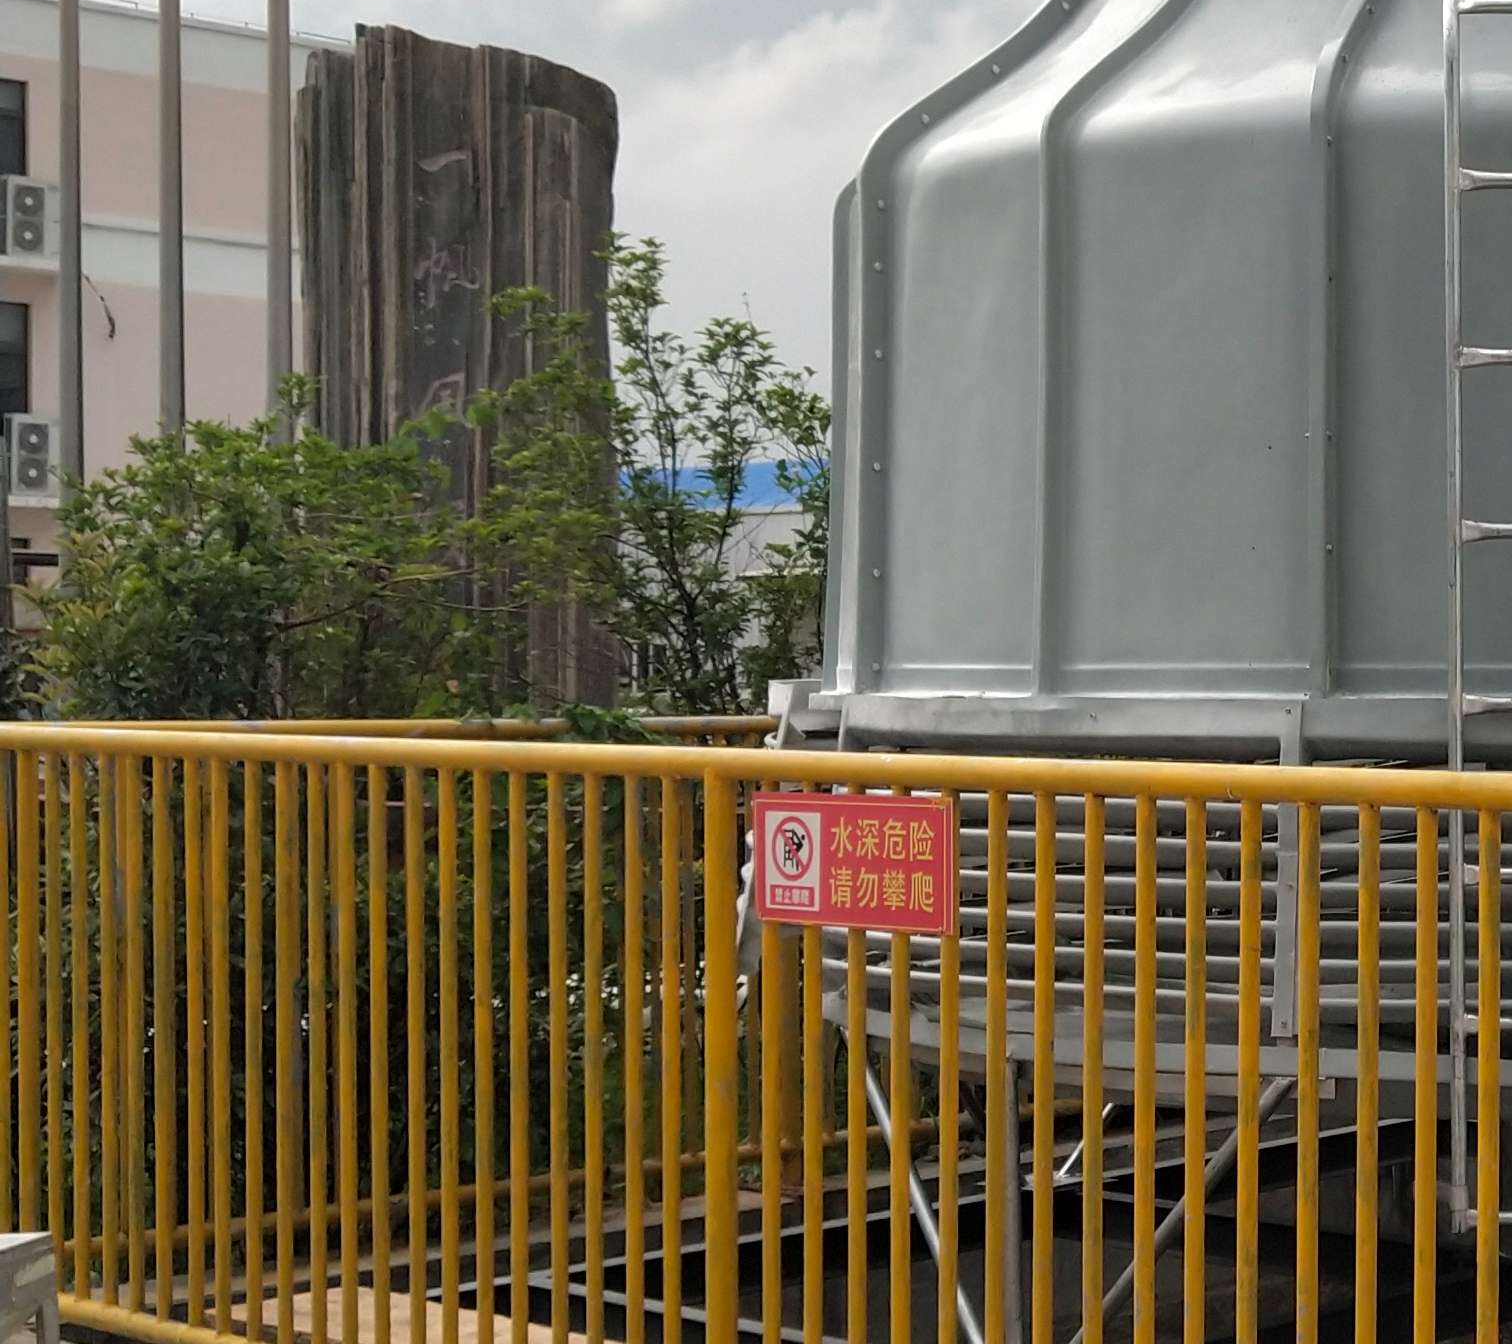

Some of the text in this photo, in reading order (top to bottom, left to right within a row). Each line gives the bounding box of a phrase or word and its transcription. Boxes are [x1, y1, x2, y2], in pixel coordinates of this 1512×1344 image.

[829, 816, 935, 862] 水深危险
[829, 865, 935, 913] 请勿攀爬
